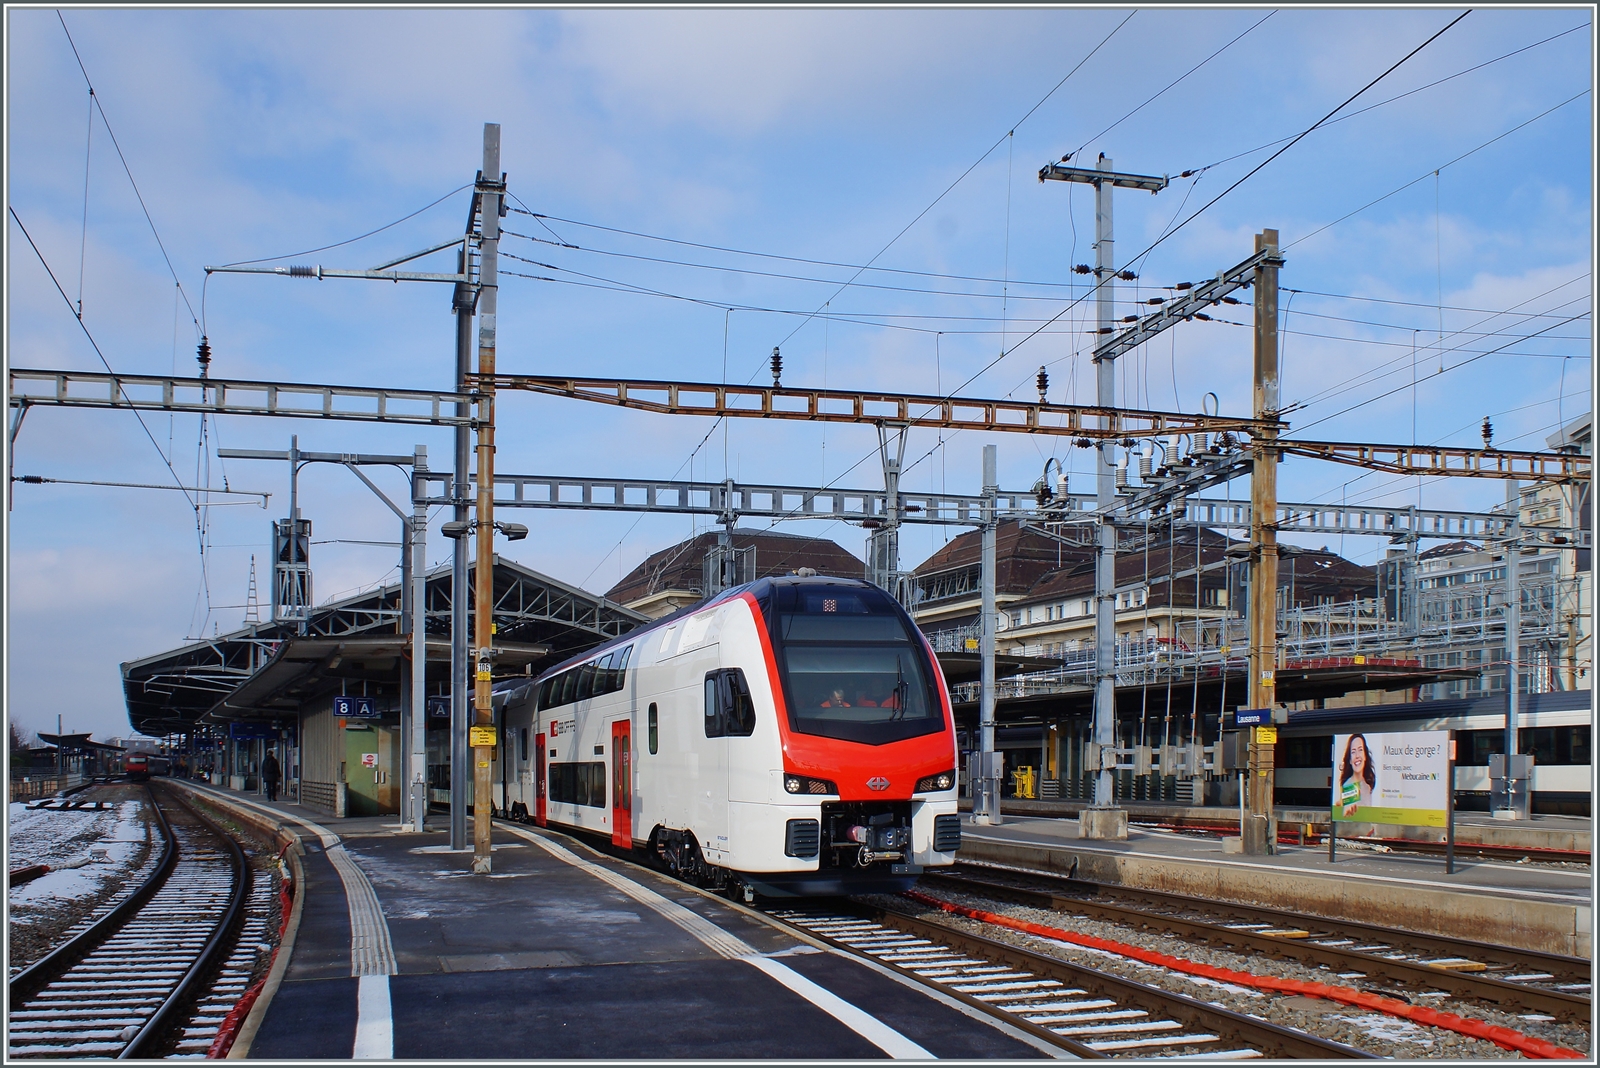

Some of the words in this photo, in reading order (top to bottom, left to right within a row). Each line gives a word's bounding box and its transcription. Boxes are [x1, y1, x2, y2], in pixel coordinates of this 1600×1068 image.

[478, 663, 489, 671] 106
[340, 702, 349, 713] 8
[360, 703, 370, 713] A
[436, 705, 445, 714] A
[1238, 715, 1260, 724] Lausanne
[1383, 745, 1403, 755] Maux
[1404, 744, 1413, 755] de
[1415, 746, 1436, 758] gorge
[1437, 744, 1441, 754] ?
